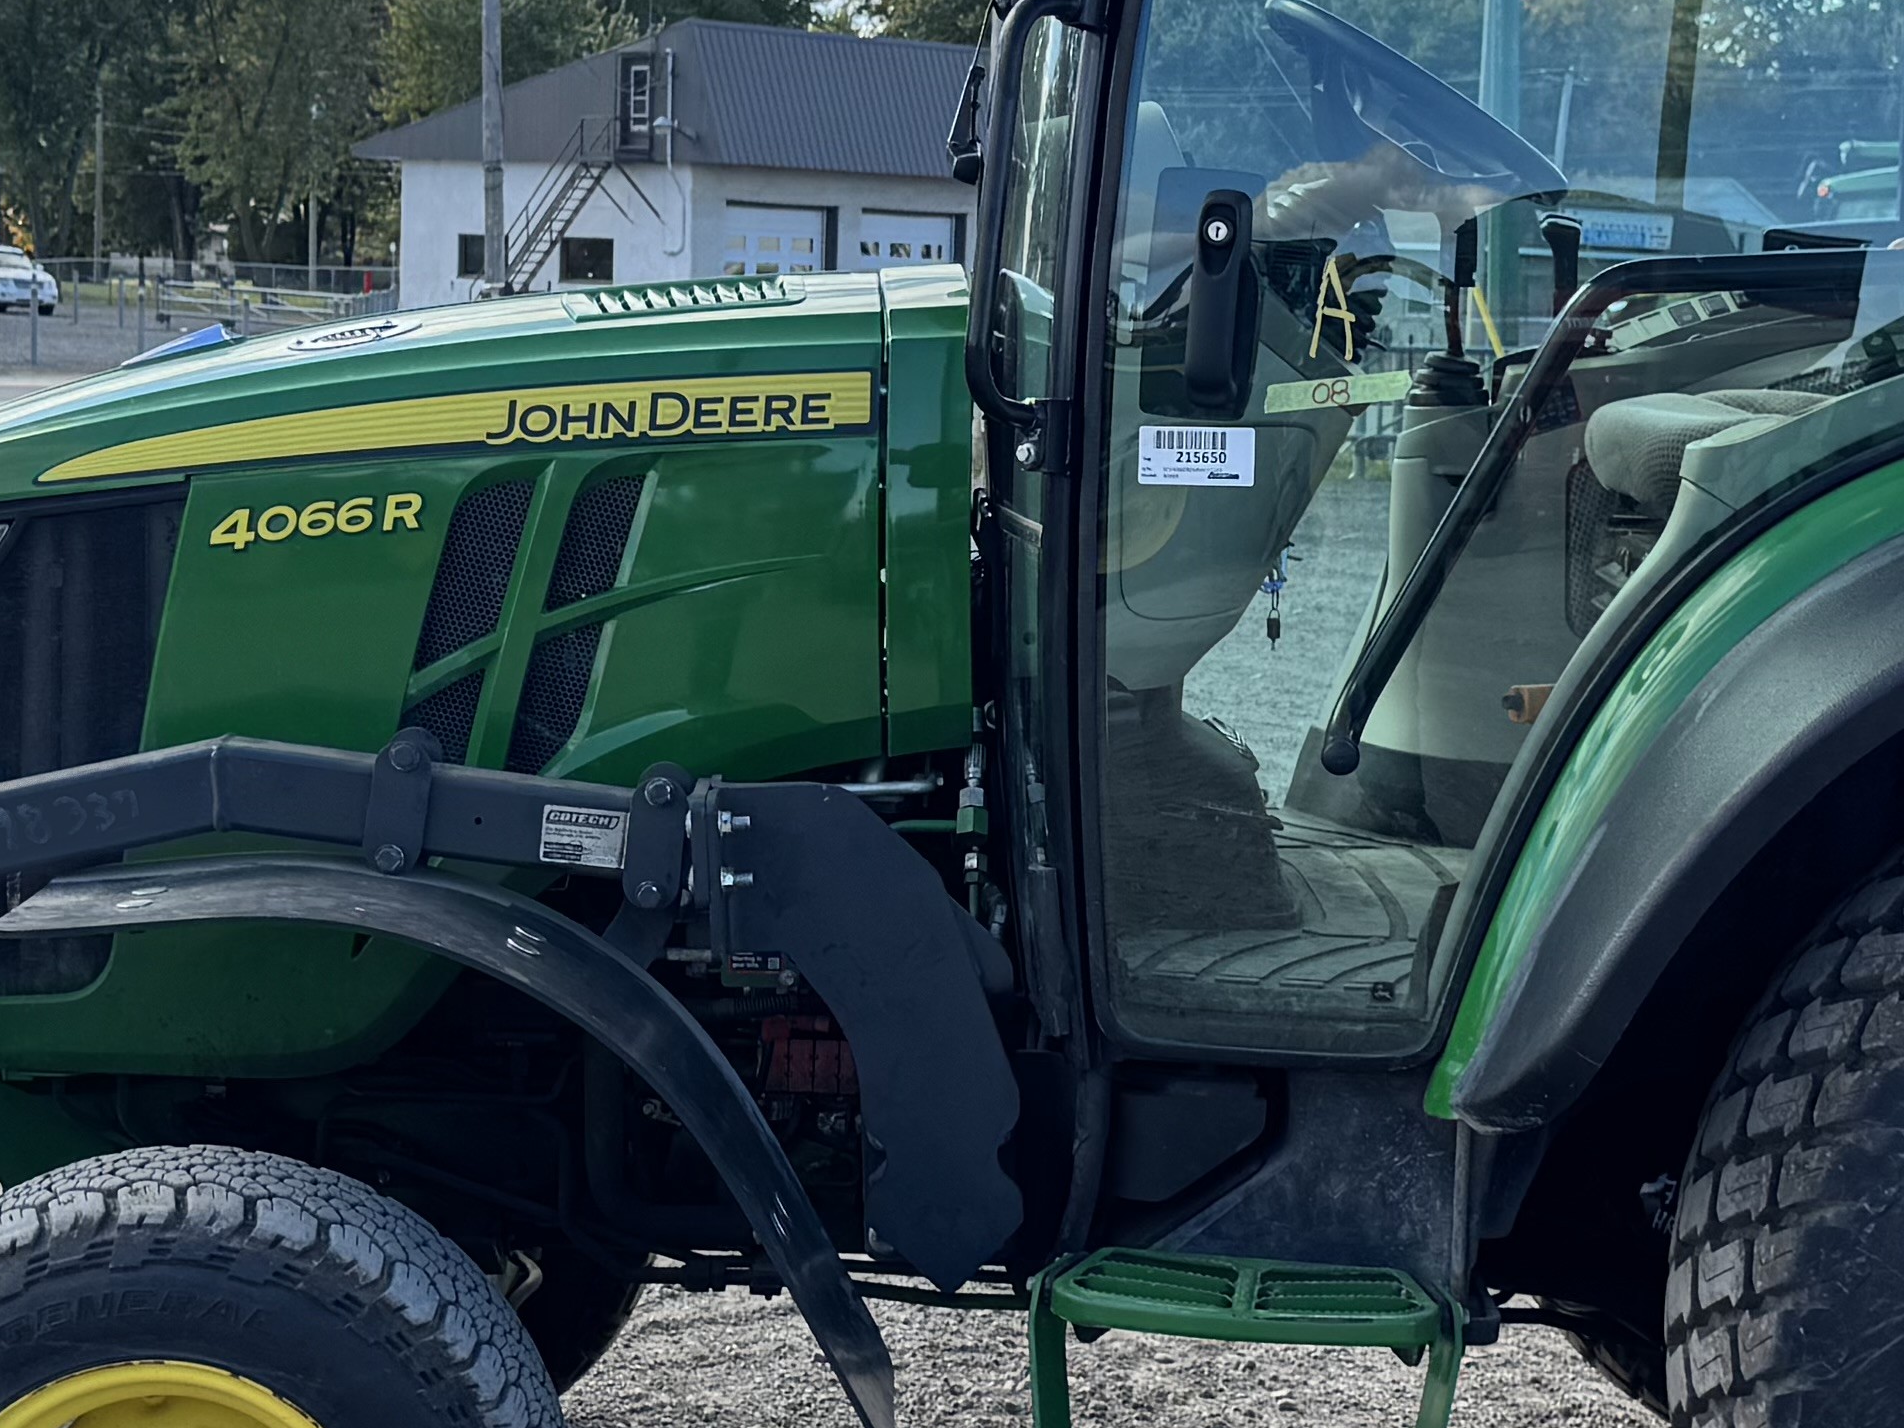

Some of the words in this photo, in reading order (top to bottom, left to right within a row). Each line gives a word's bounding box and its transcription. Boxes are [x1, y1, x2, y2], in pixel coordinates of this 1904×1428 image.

[1309, 256, 1356, 361] A
[486, 397, 642, 444] JOHN
[647, 391, 833, 438] DEERE
[1176, 451, 1227, 464] 215650
[208, 492, 425, 550] 4066R
[549, 811, 610, 826] COTECH
